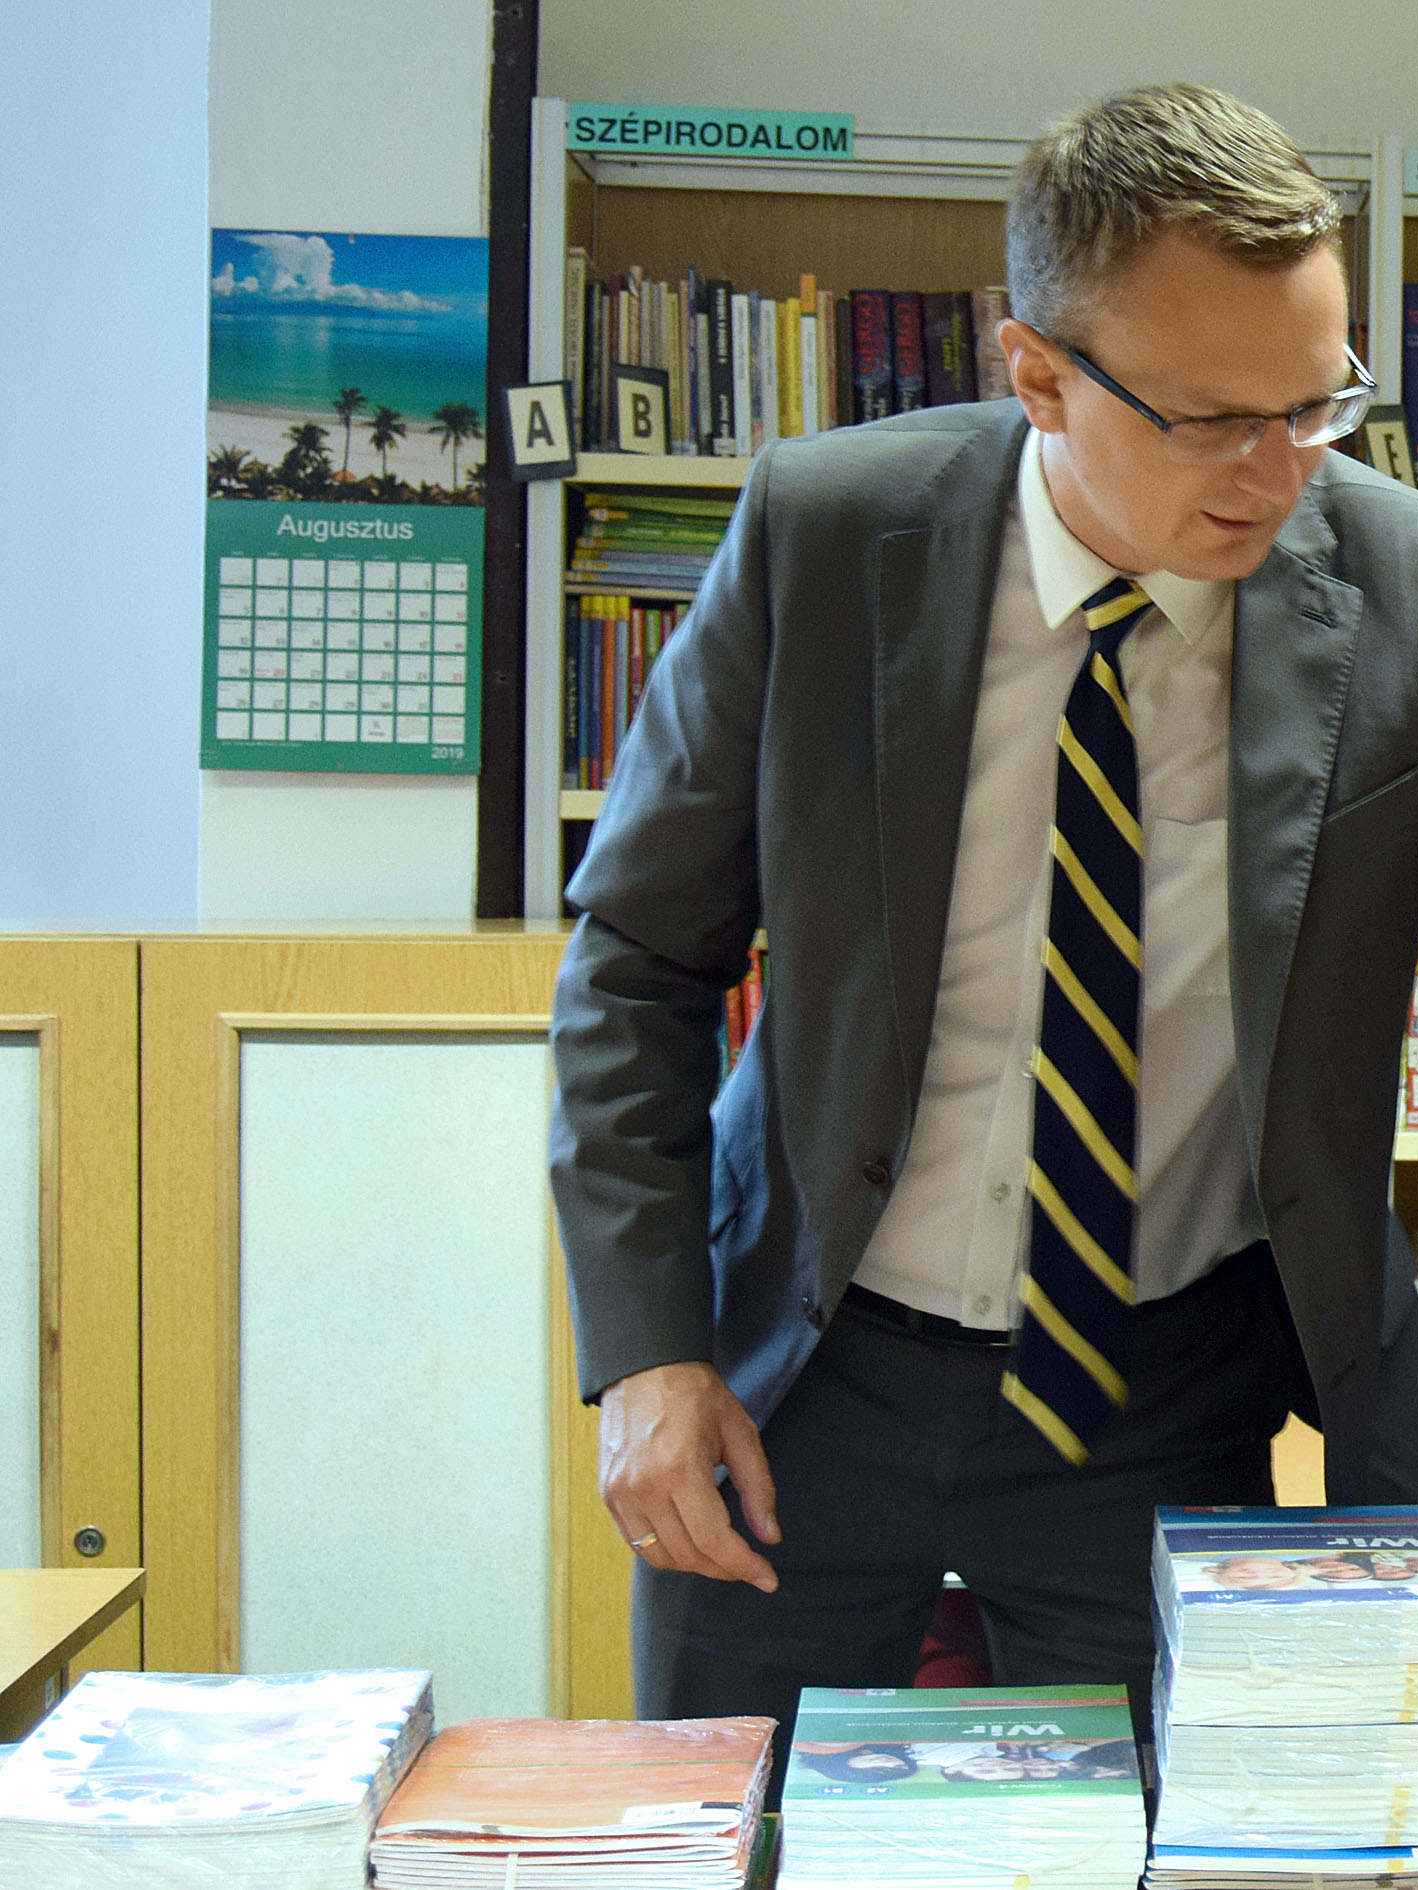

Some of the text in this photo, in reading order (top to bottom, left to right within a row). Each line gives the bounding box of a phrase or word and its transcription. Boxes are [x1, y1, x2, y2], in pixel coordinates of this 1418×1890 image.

[574, 112, 849, 153] SZÉPIRODALOM
[525, 398, 555, 450] A
[631, 393, 653, 438] B
[1384, 432, 1402, 479] E
[276, 514, 415, 542] Augusztus
[431, 746, 465, 760] 2019
[962, 1723, 1065, 1737] Wir
